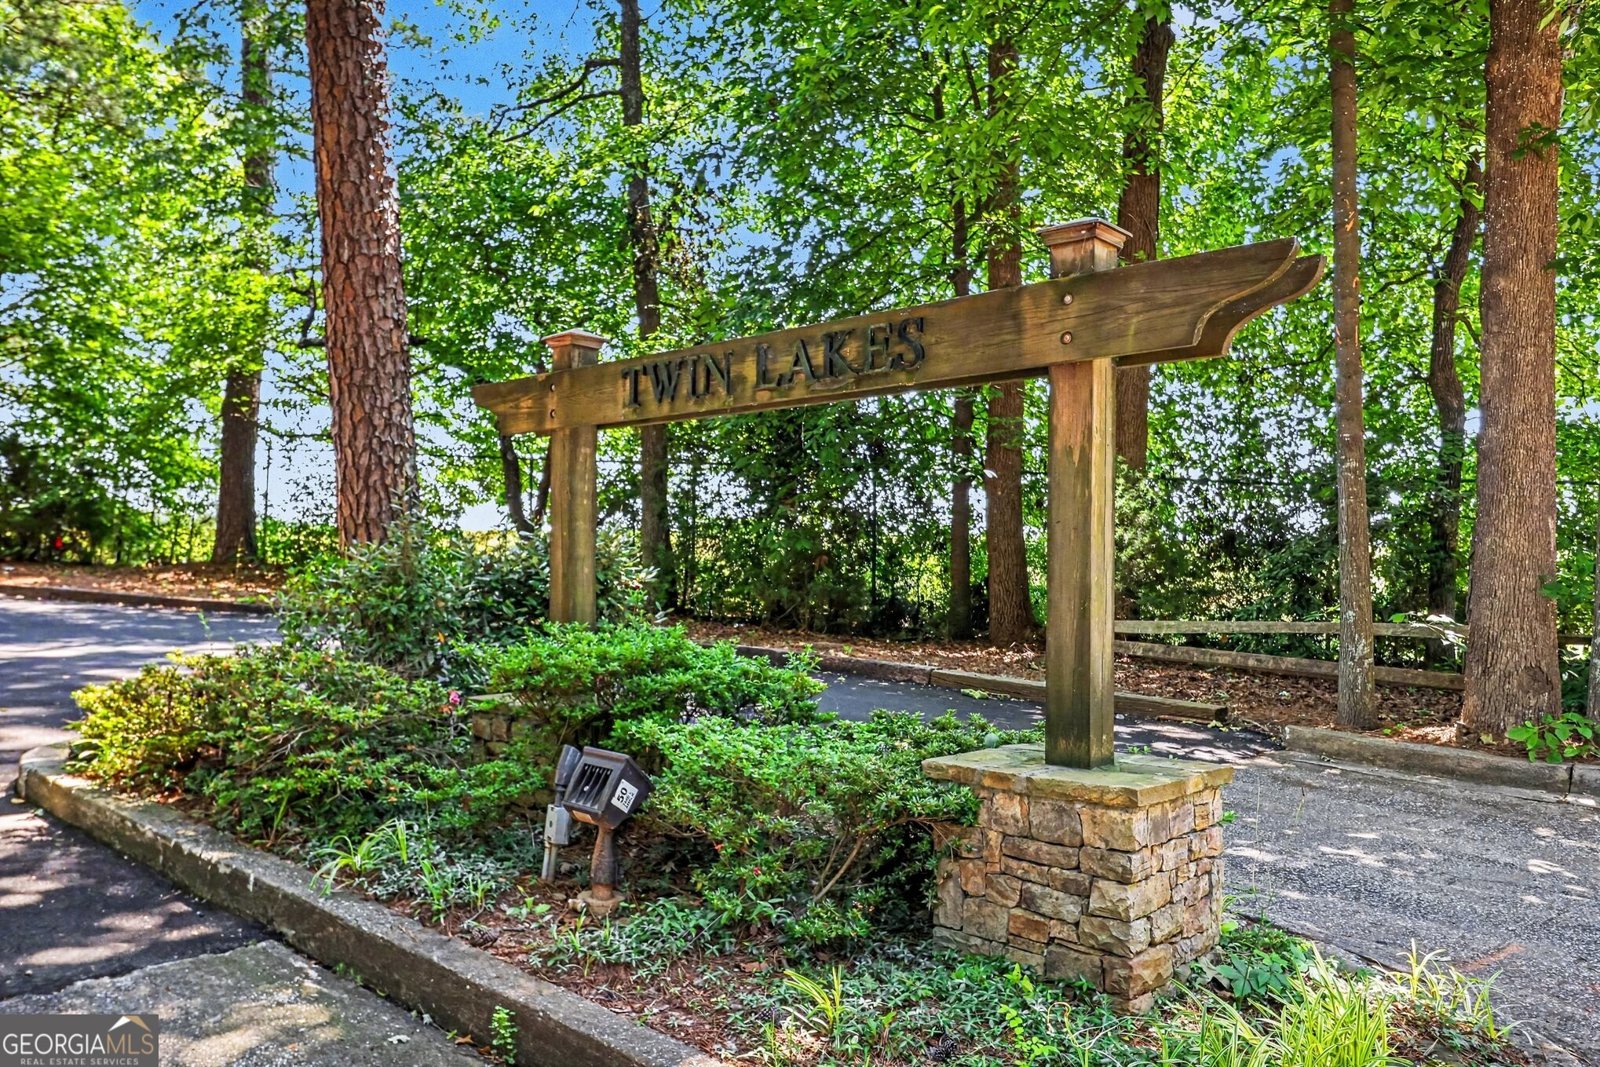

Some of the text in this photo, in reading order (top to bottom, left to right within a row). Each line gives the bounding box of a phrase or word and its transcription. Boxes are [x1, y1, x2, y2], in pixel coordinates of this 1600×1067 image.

[621, 317, 926, 408] TWIN LAKES
[617, 787, 628, 803] 50
